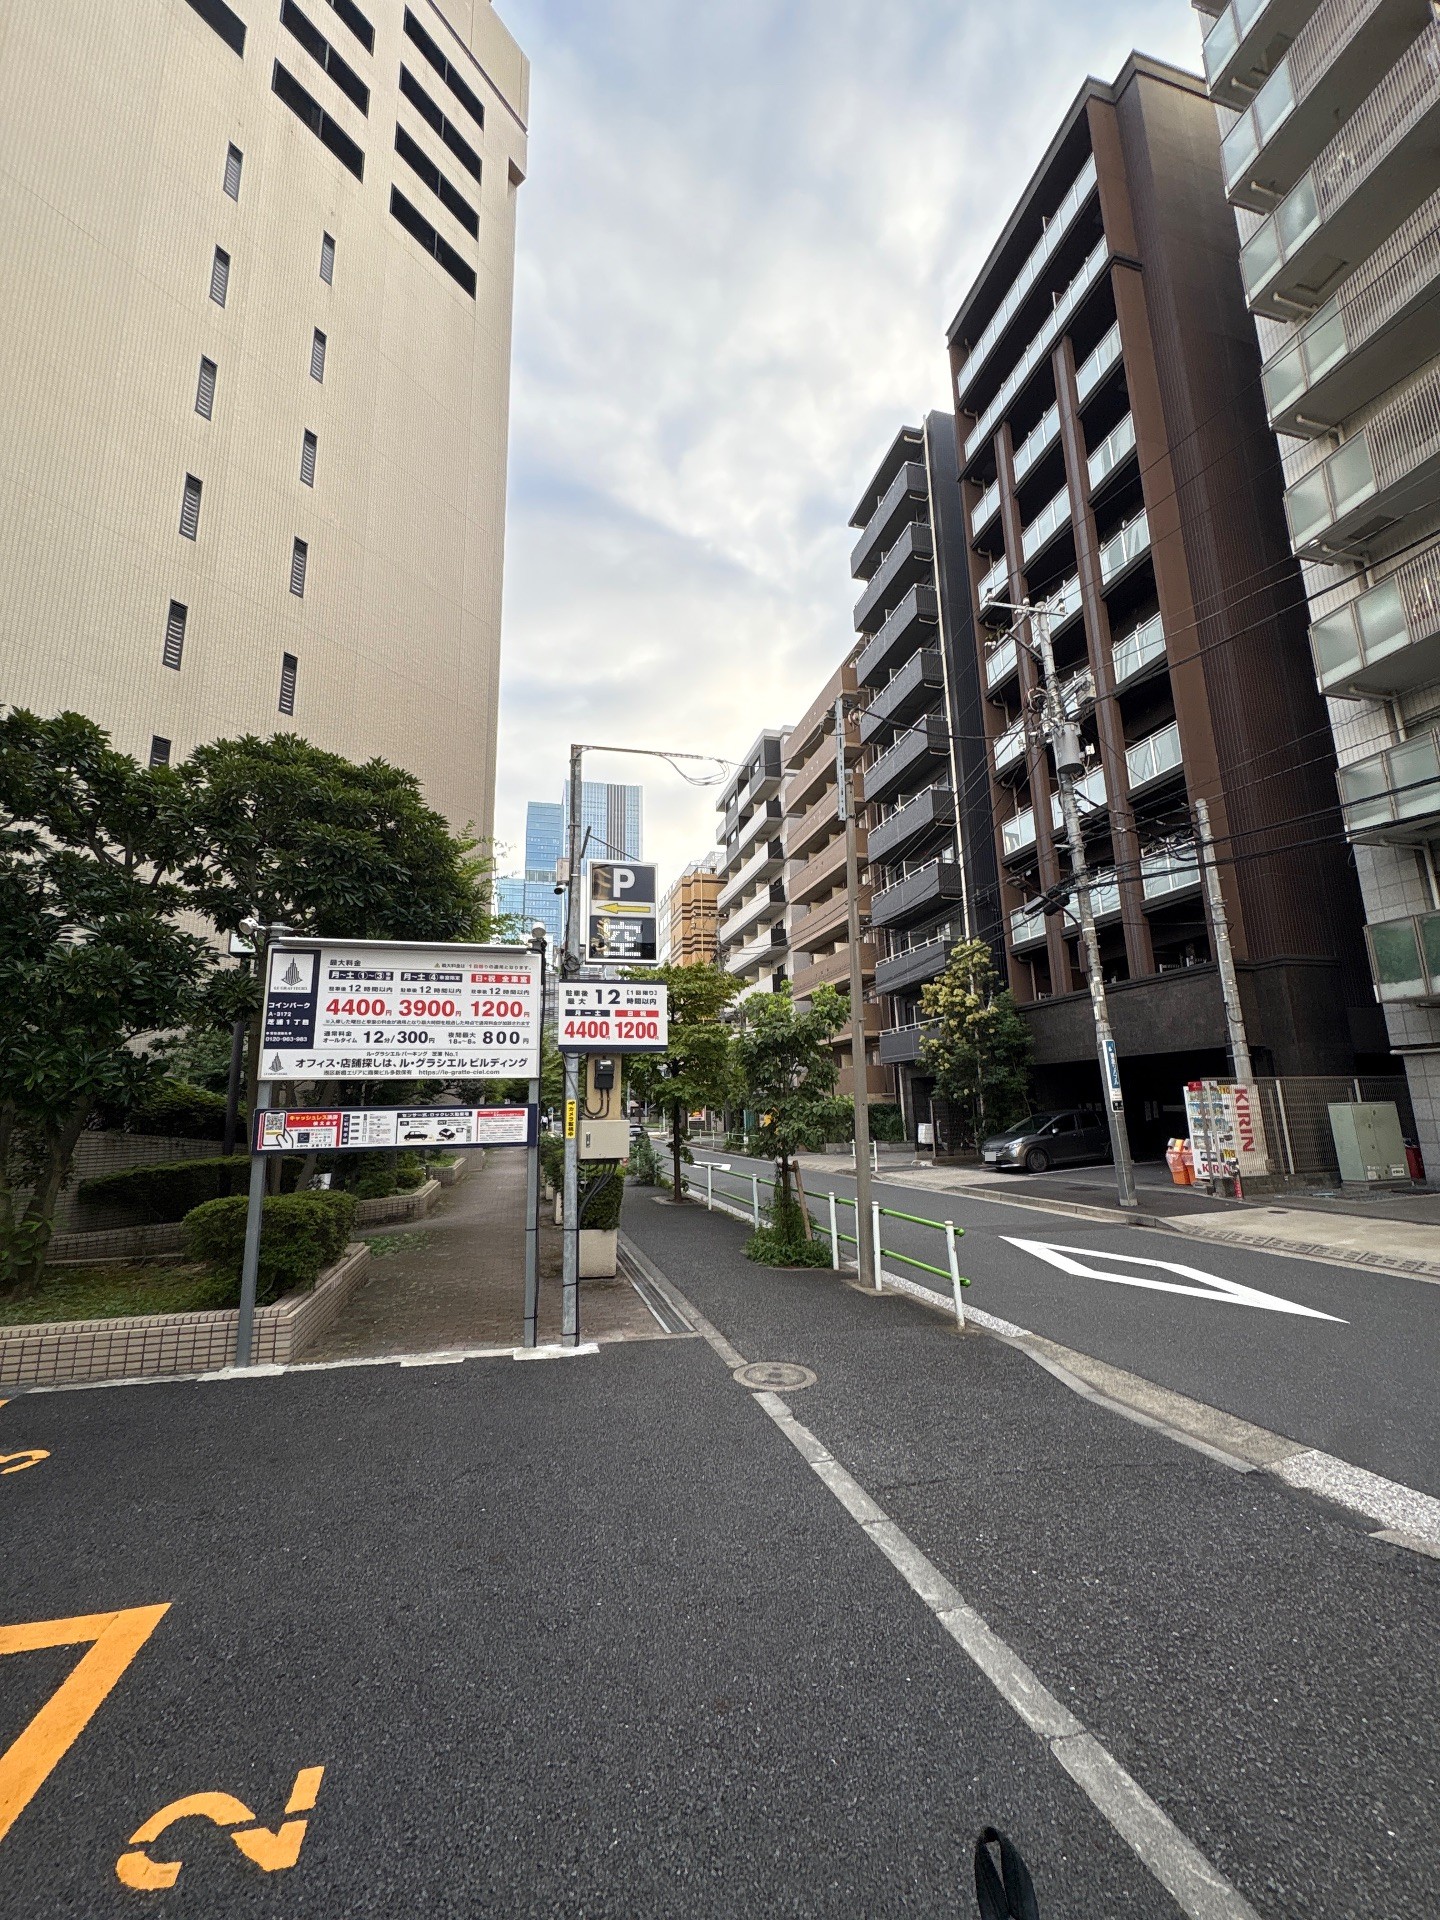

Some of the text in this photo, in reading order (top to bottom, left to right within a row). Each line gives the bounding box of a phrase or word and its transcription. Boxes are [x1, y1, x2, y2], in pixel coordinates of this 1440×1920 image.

[612, 868, 635, 898] P
[603, 921, 641, 956] 空
[330, 959, 361, 967] 最大料金
[595, 989, 621, 1005] 12
[1234, 1088, 1255, 1152] KIRIN
[116, 1765, 325, 1891] 2
